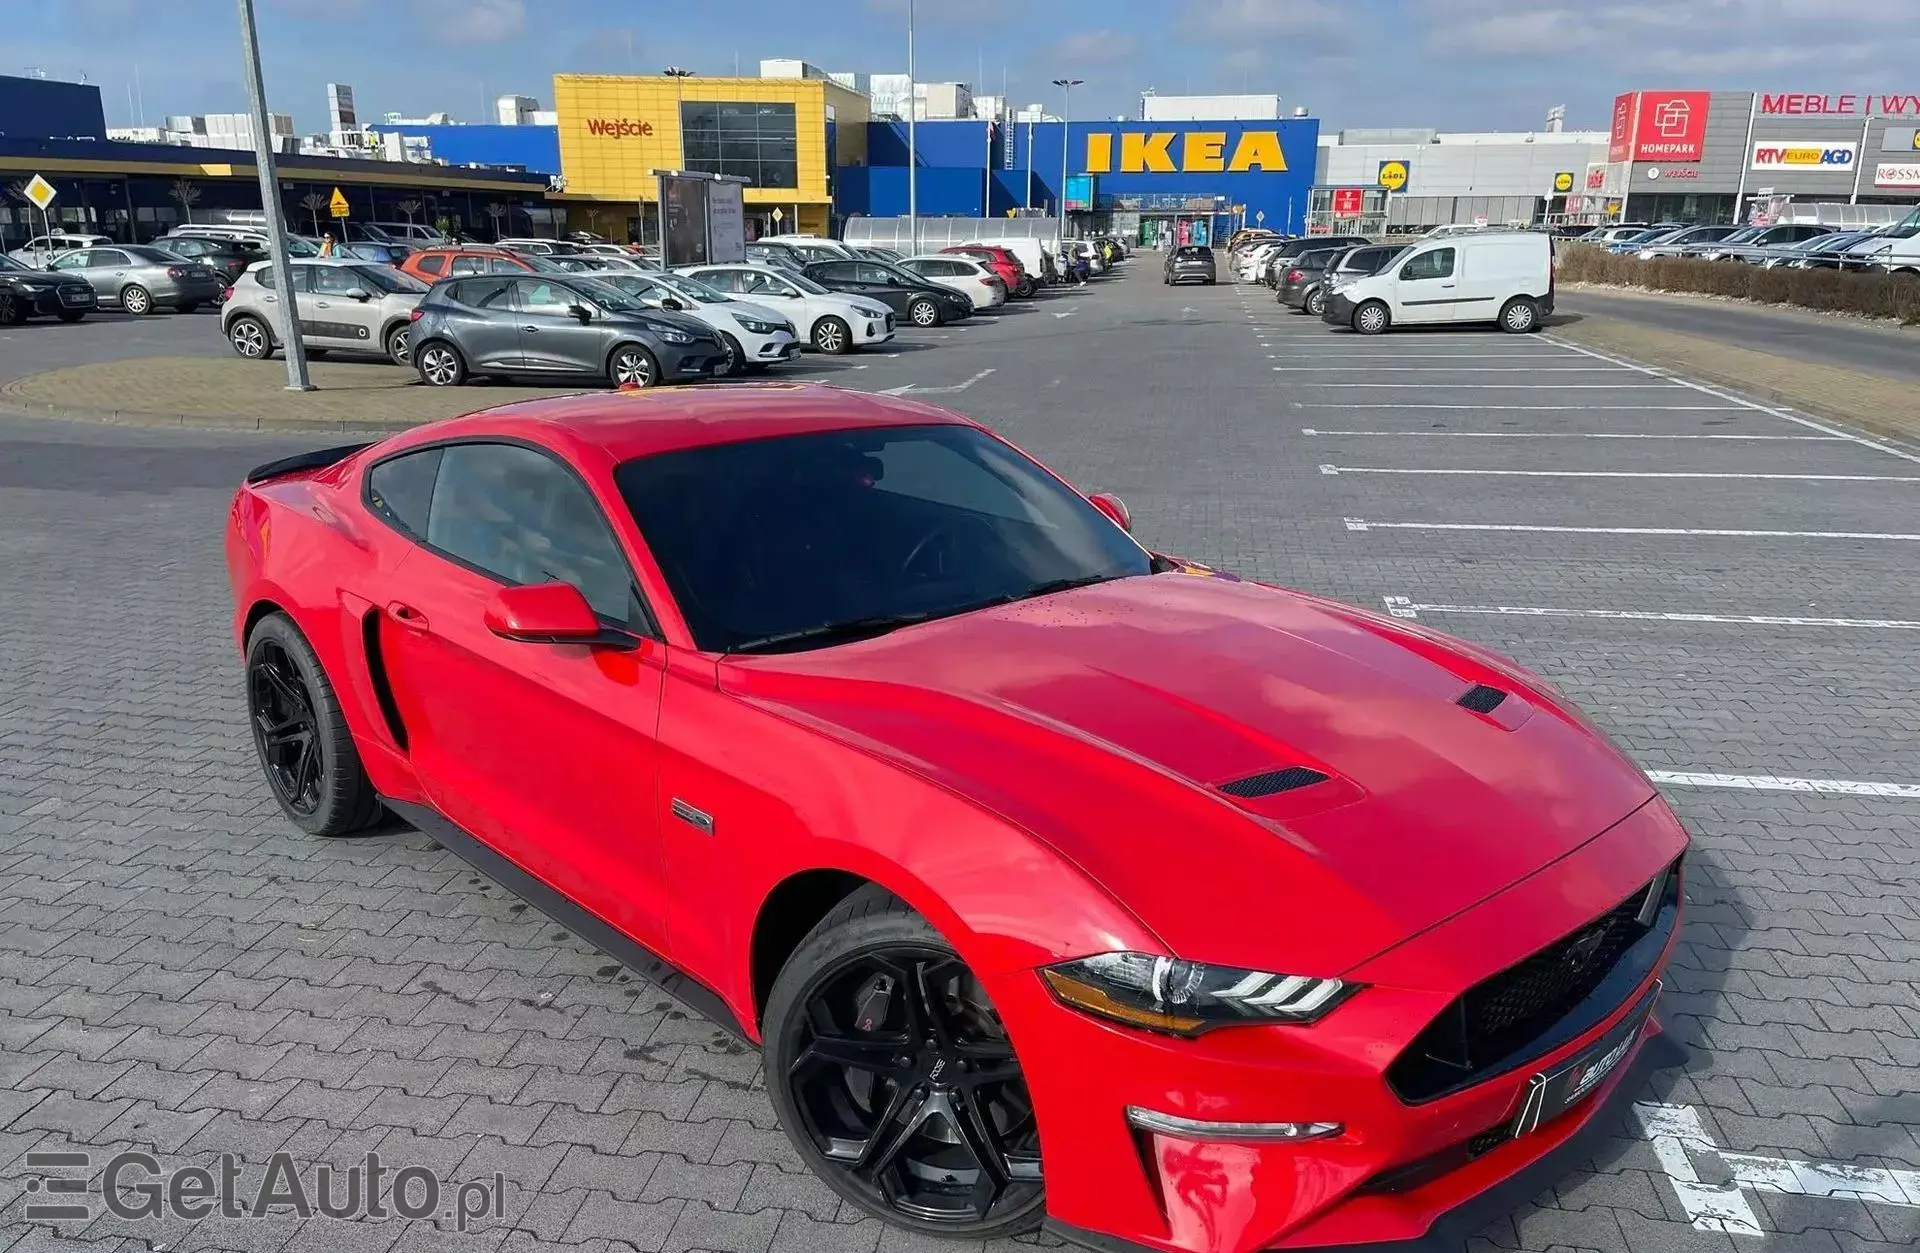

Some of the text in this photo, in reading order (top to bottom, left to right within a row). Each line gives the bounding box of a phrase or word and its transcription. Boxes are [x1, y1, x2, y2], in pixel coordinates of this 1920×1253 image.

[1761, 94, 1856, 114] MEBLE
[1865, 95, 1872, 115] I
[587, 118, 653, 139] Wejście
[1087, 131, 1288, 173] IKEA
[1641, 143, 1695, 153] HOMEPARK
[1756, 148, 1853, 164] RTV EURO AGD
